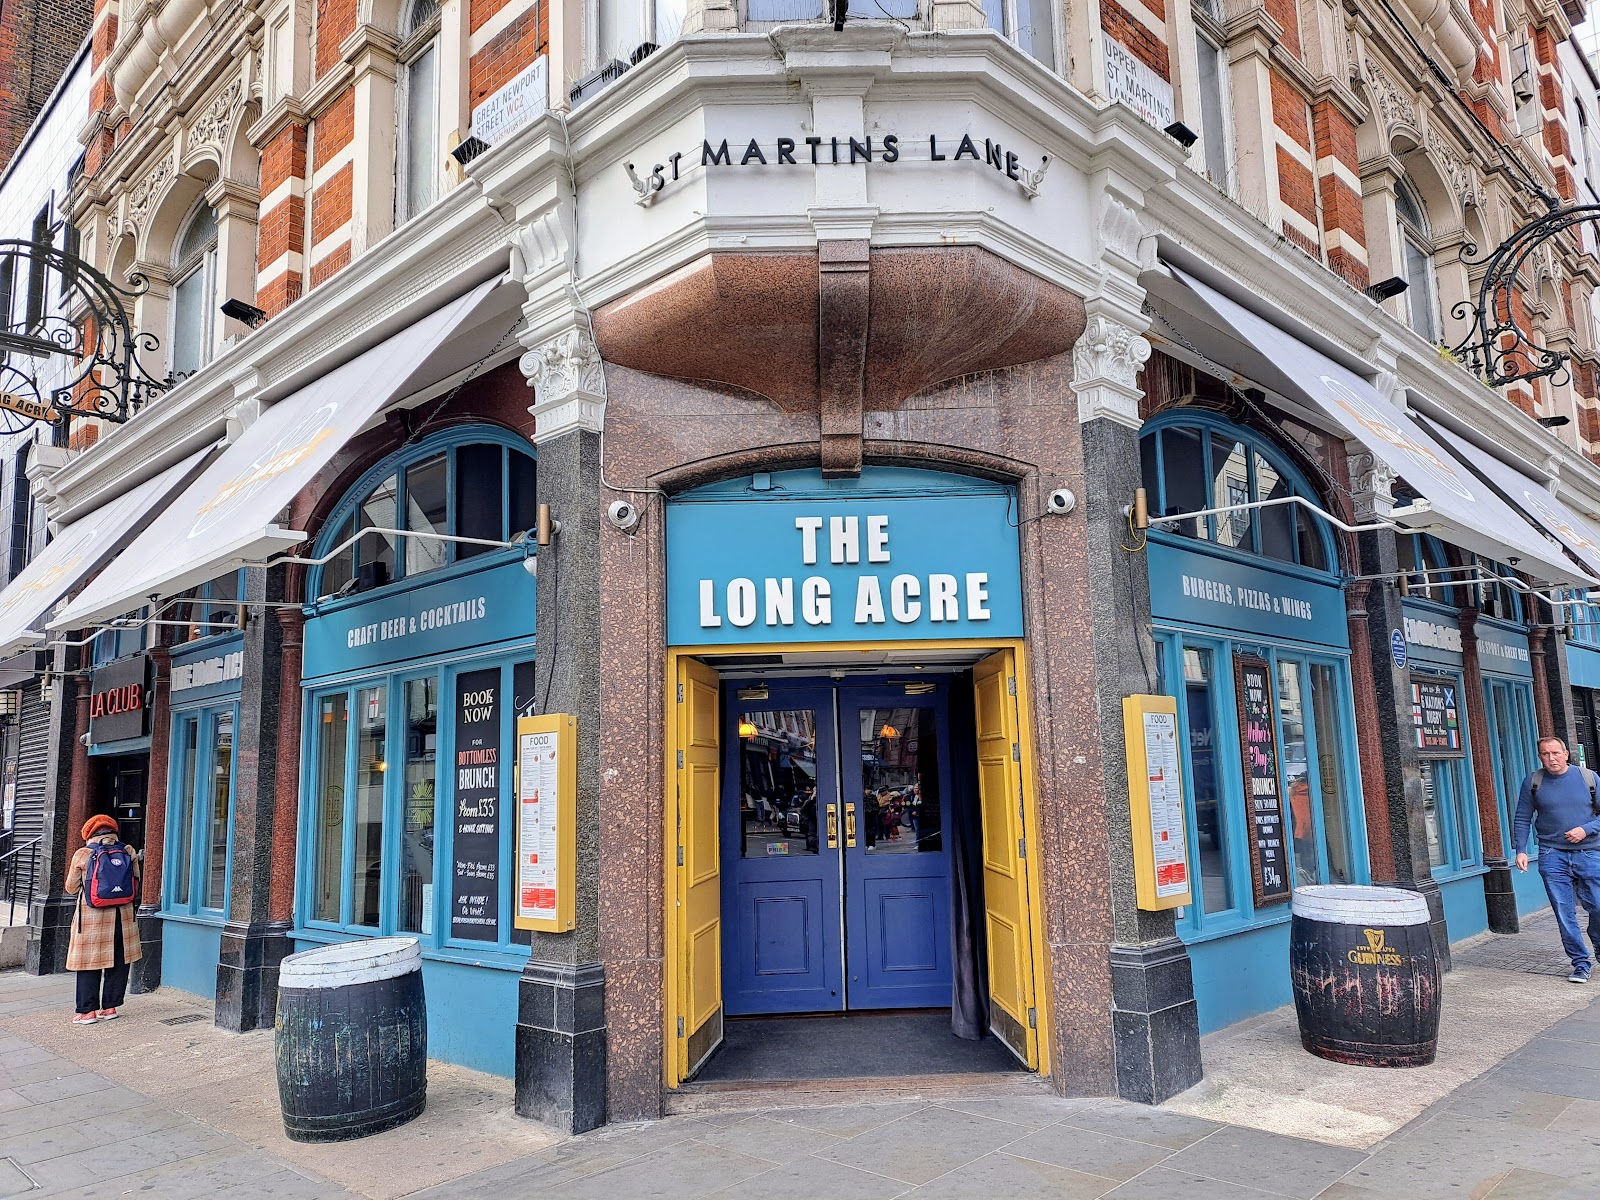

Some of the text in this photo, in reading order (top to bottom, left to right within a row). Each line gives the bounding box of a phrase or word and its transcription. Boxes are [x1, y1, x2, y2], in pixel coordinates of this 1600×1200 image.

[1104, 38, 1138, 78] UPPER
[476, 64, 541, 125] GREAT NEWPORT
[1107, 61, 1171, 124] ST. MARTIN'S
[476, 93, 524, 138] STREET WC2
[651, 133, 1020, 191] ST MARTINS LANE
[795, 515, 891, 564] THE
[699, 572, 991, 628] LONG ACRE
[1182, 575, 1312, 621] BURGERS, PIZZAS & WINGS
[347, 596, 486, 649] CRAFT BEER & COCKTAILS
[1504, 645, 1518, 660] GREAT
[1517, 647, 1529, 662] BEER
[1246, 674, 1262, 689] BOOK
[90, 683, 142, 719] LA CLUB
[463, 688, 494, 707] BOOK
[1249, 689, 1262, 702] NOW
[1420, 694, 1445, 711] 6 NATIONS
[463, 705, 493, 724] NOW
[1150, 714, 1167, 724] FOOD
[1426, 710, 1442, 725] RUGBY
[529, 735, 549, 747] FOOD
[458, 748, 497, 766] BOTTOMLESS
[458, 766, 496, 791] BRUNCH
[1252, 778, 1276, 796] BRUNCH
[1347, 949, 1403, 967] GUINNESS
